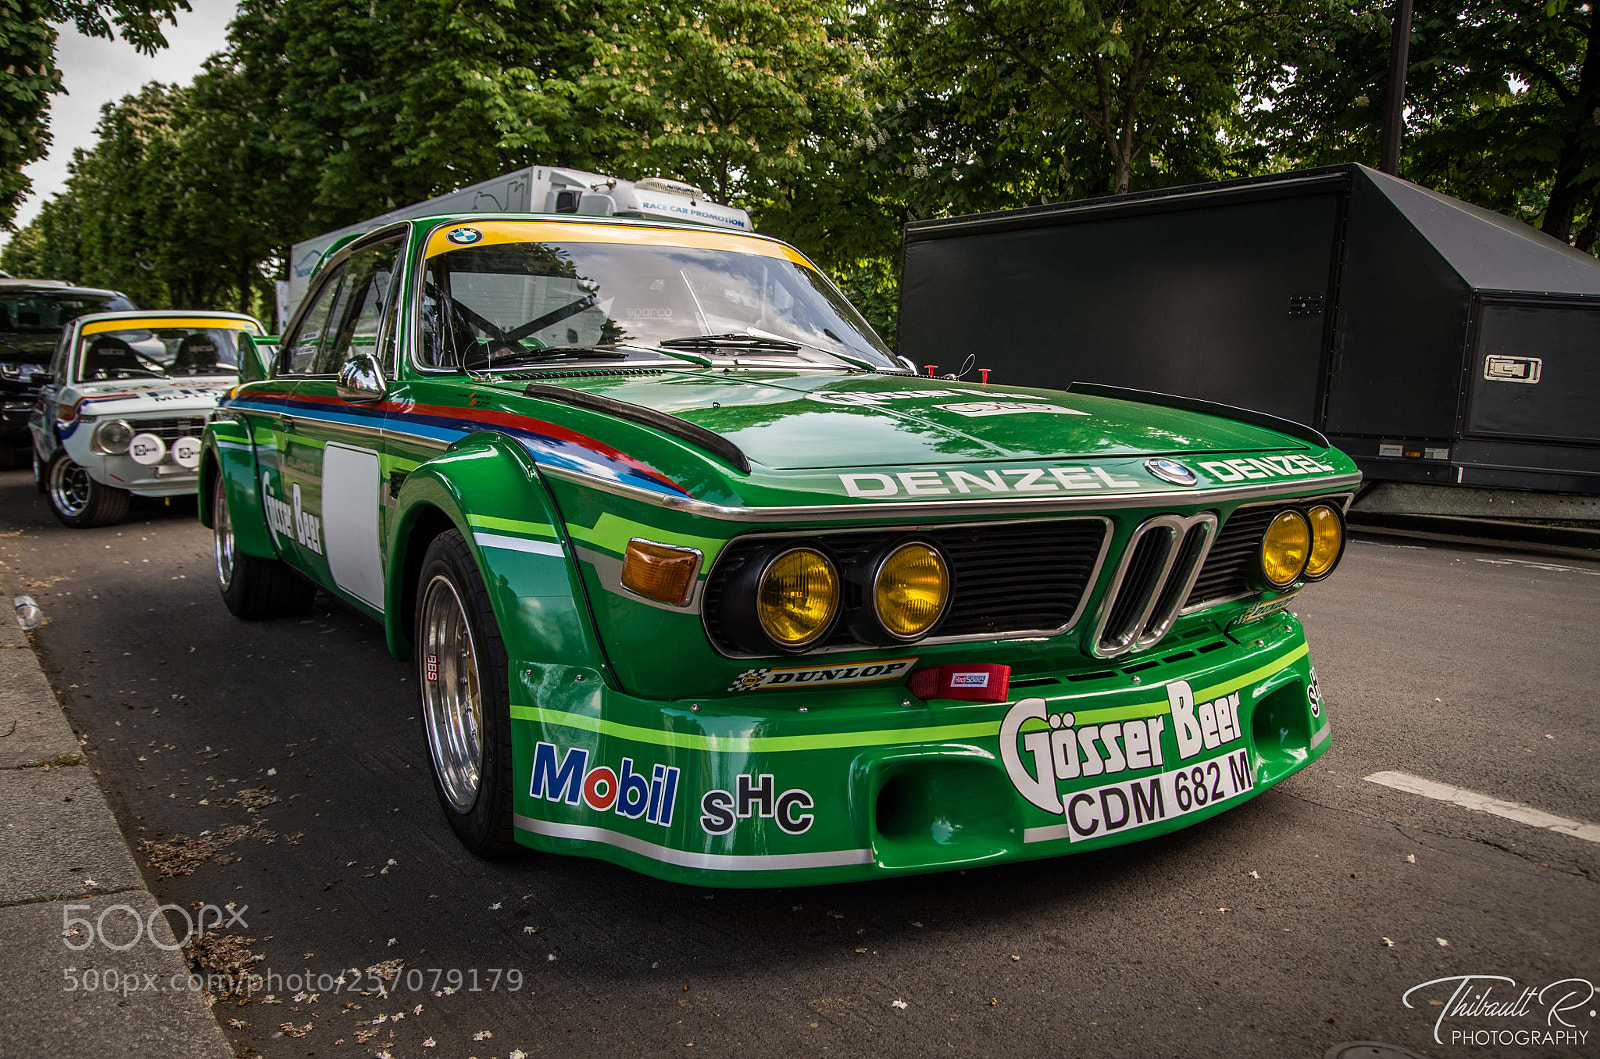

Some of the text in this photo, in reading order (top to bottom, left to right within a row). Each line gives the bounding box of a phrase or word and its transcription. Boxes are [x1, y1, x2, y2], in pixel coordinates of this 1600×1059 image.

[643, 202, 745, 228] RACE CAR PROMOTION
[838, 466, 1141, 498] DENZEL
[1197, 454, 1335, 482] DENZEL
[427, 655, 438, 681] BBS
[767, 662, 907, 684] DUNLOP
[999, 679, 1242, 816] Gösser Beer
[529, 741, 680, 827] Mobil
[1068, 751, 1253, 837] CDM 682 M
